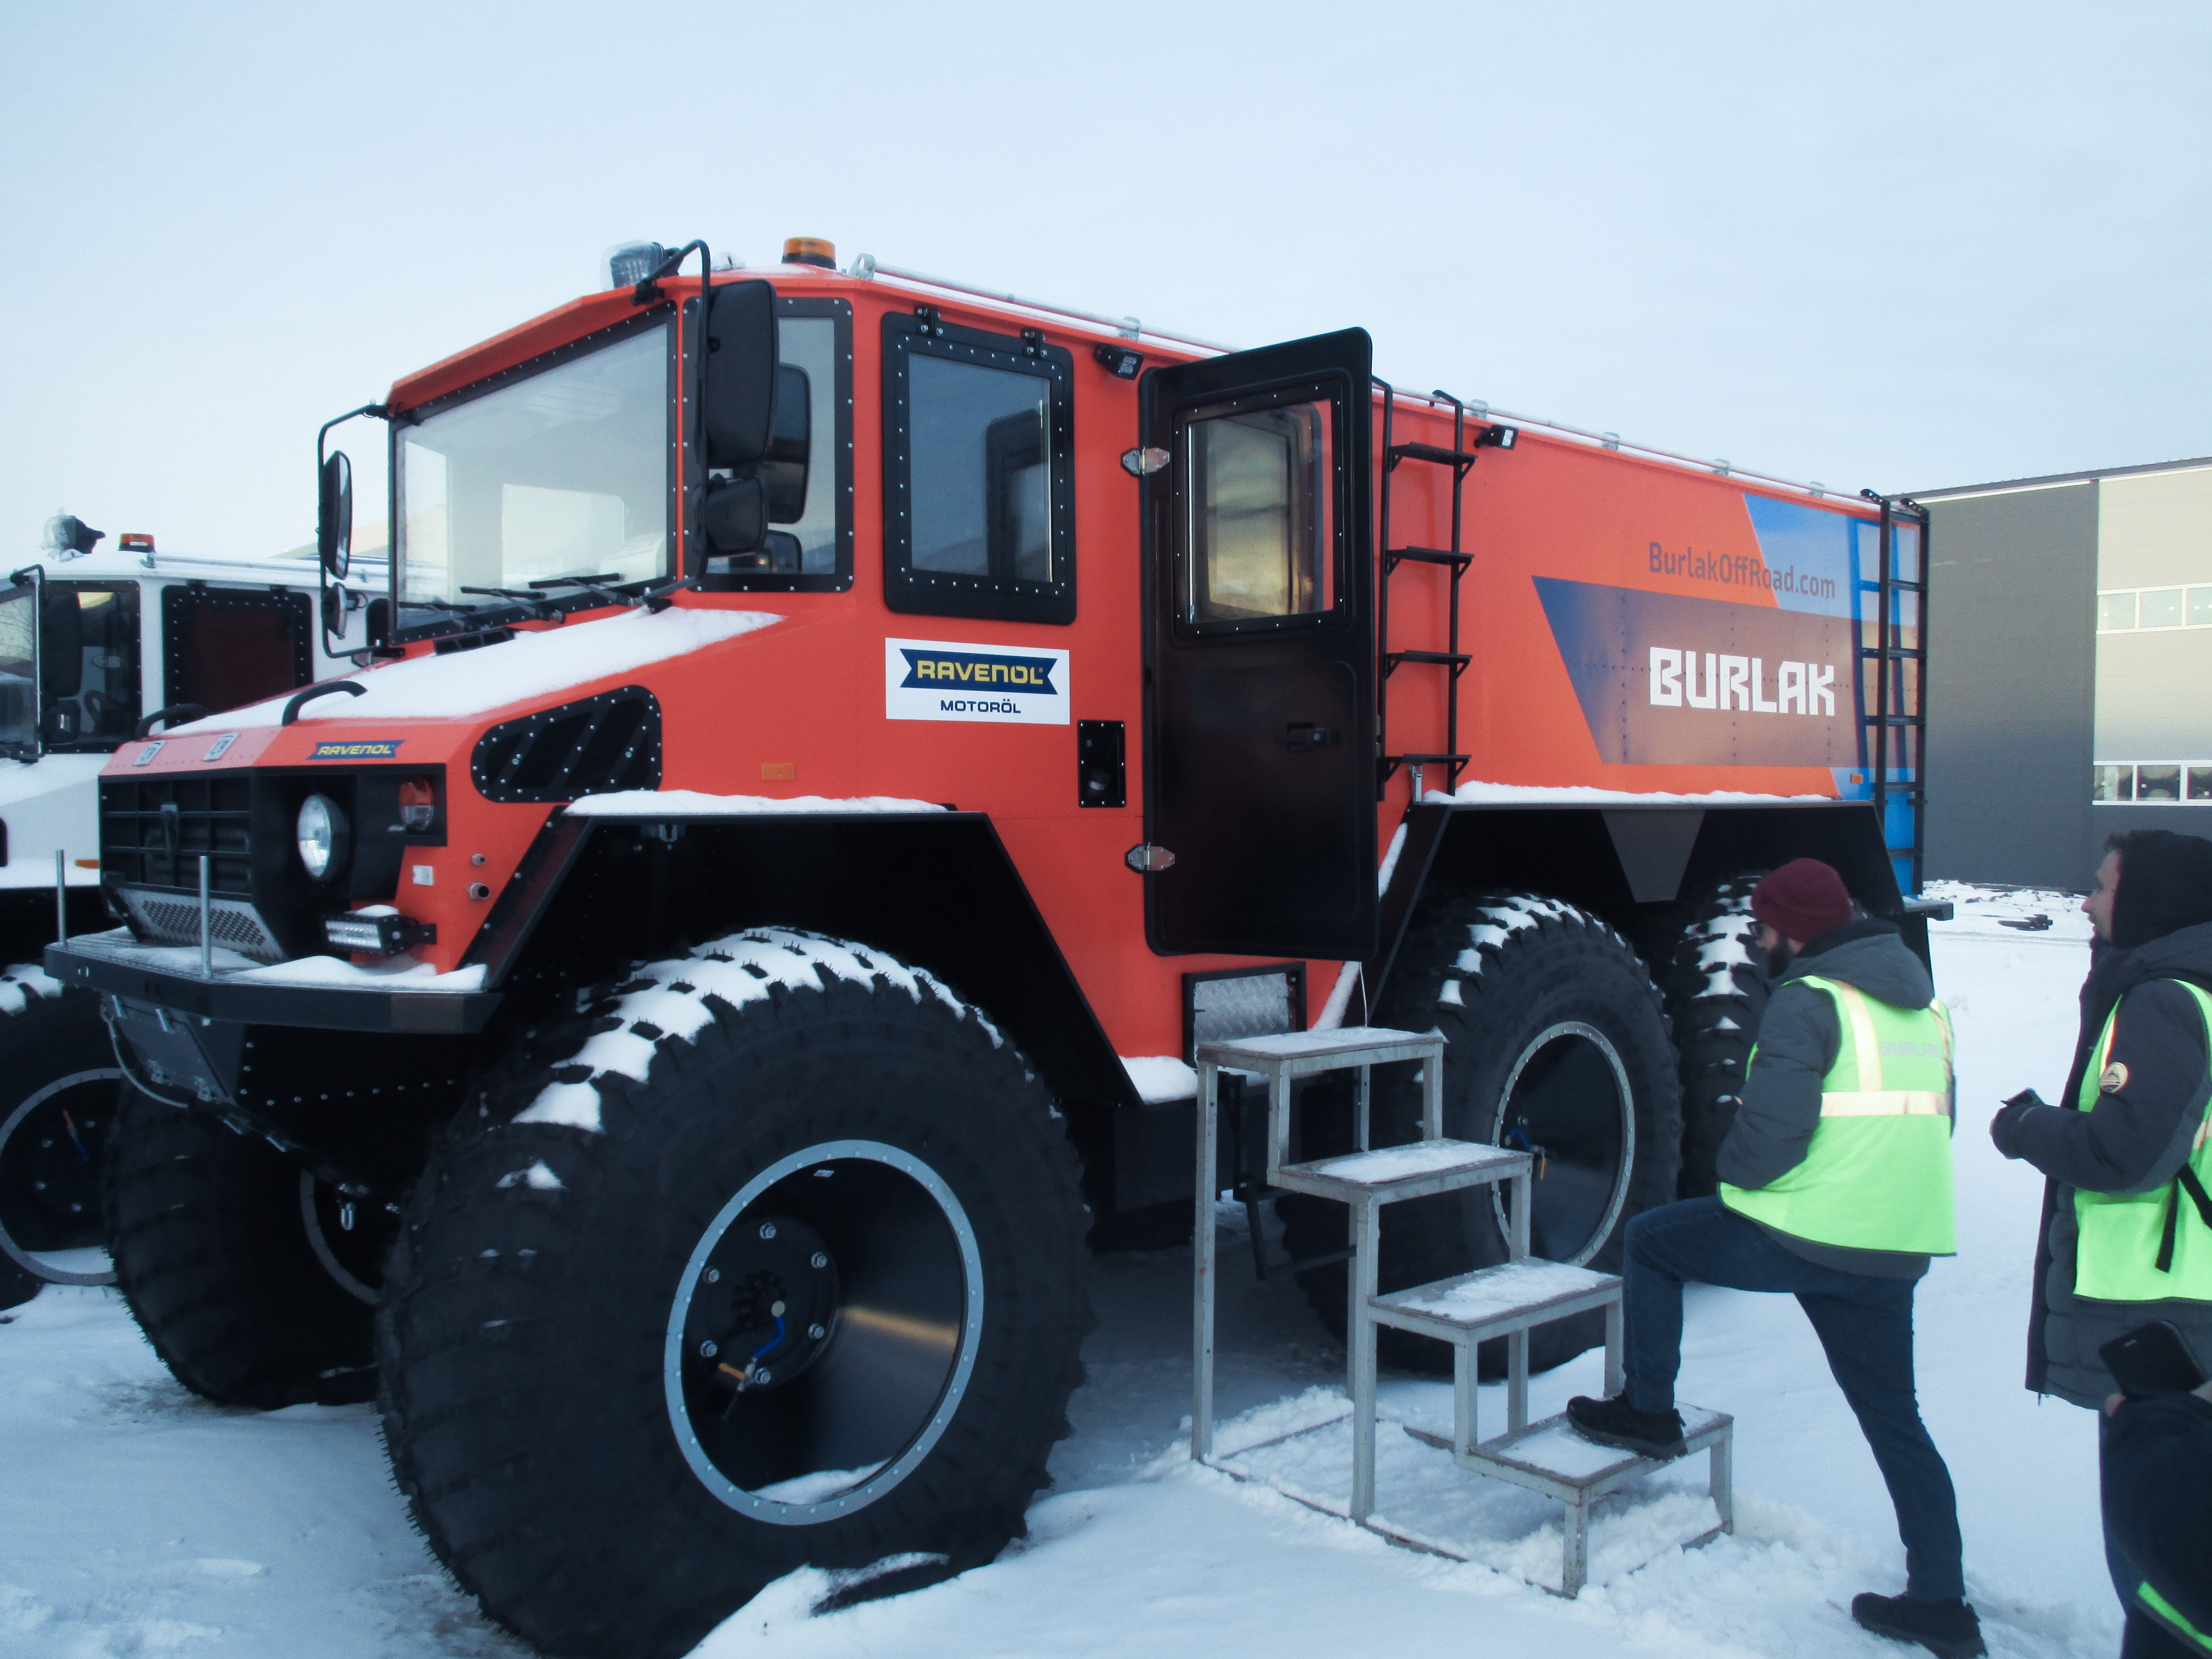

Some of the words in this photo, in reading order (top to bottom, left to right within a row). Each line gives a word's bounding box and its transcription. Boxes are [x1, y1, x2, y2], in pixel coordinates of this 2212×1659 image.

[1649, 541, 1835, 599] BurlakOffRoad.com
[917, 660, 1044, 685] RAVENOL
[1650, 647, 1835, 716] BURLAK
[940, 698, 1022, 714] MOTORÖL
